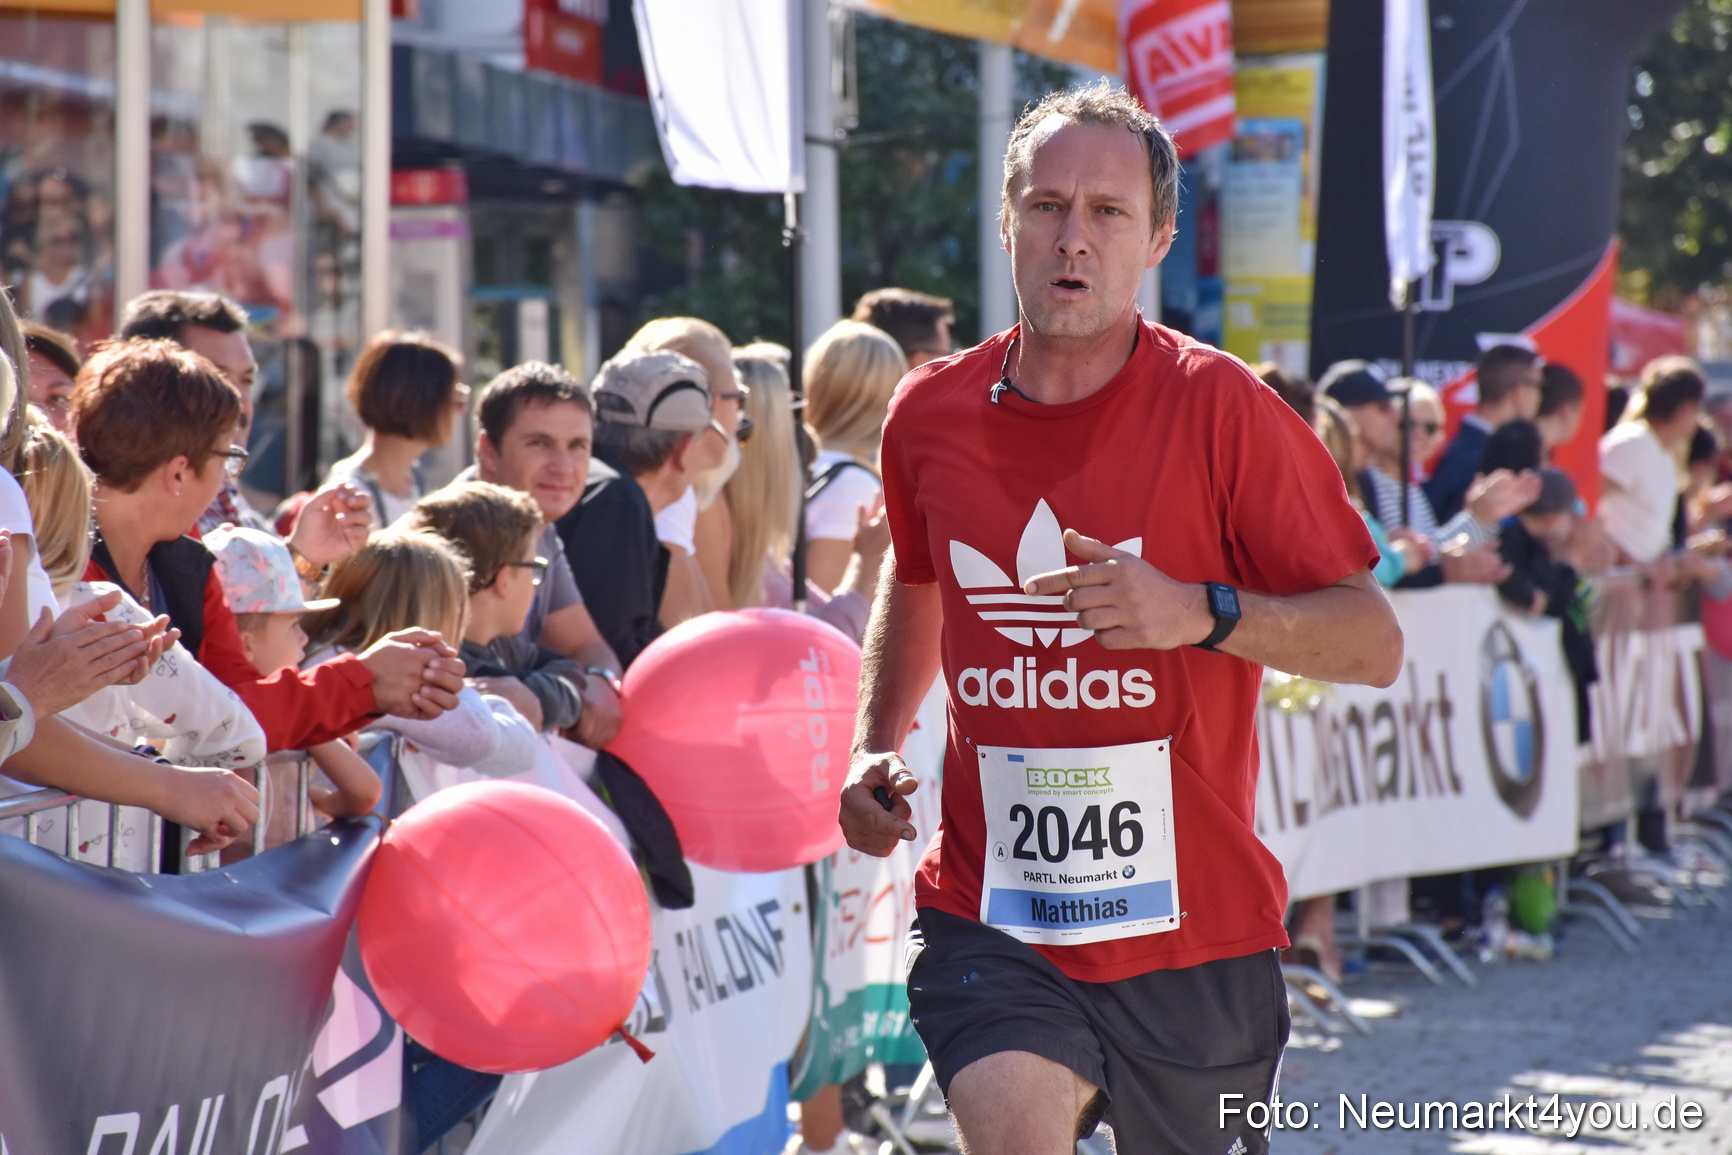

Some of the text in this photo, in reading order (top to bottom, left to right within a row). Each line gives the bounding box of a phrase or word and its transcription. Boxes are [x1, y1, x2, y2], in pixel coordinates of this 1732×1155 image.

[957, 656, 1156, 710] adidas
[1026, 767, 1113, 788] BOCK
[1027, 787, 1114, 797] inspired by smart concepts
[1009, 801, 1144, 863] 2046
[997, 847, 1004, 857] A
[1023, 870, 1118, 884] PARTL Neumarkt
[1031, 897, 1128, 924] Matthias
